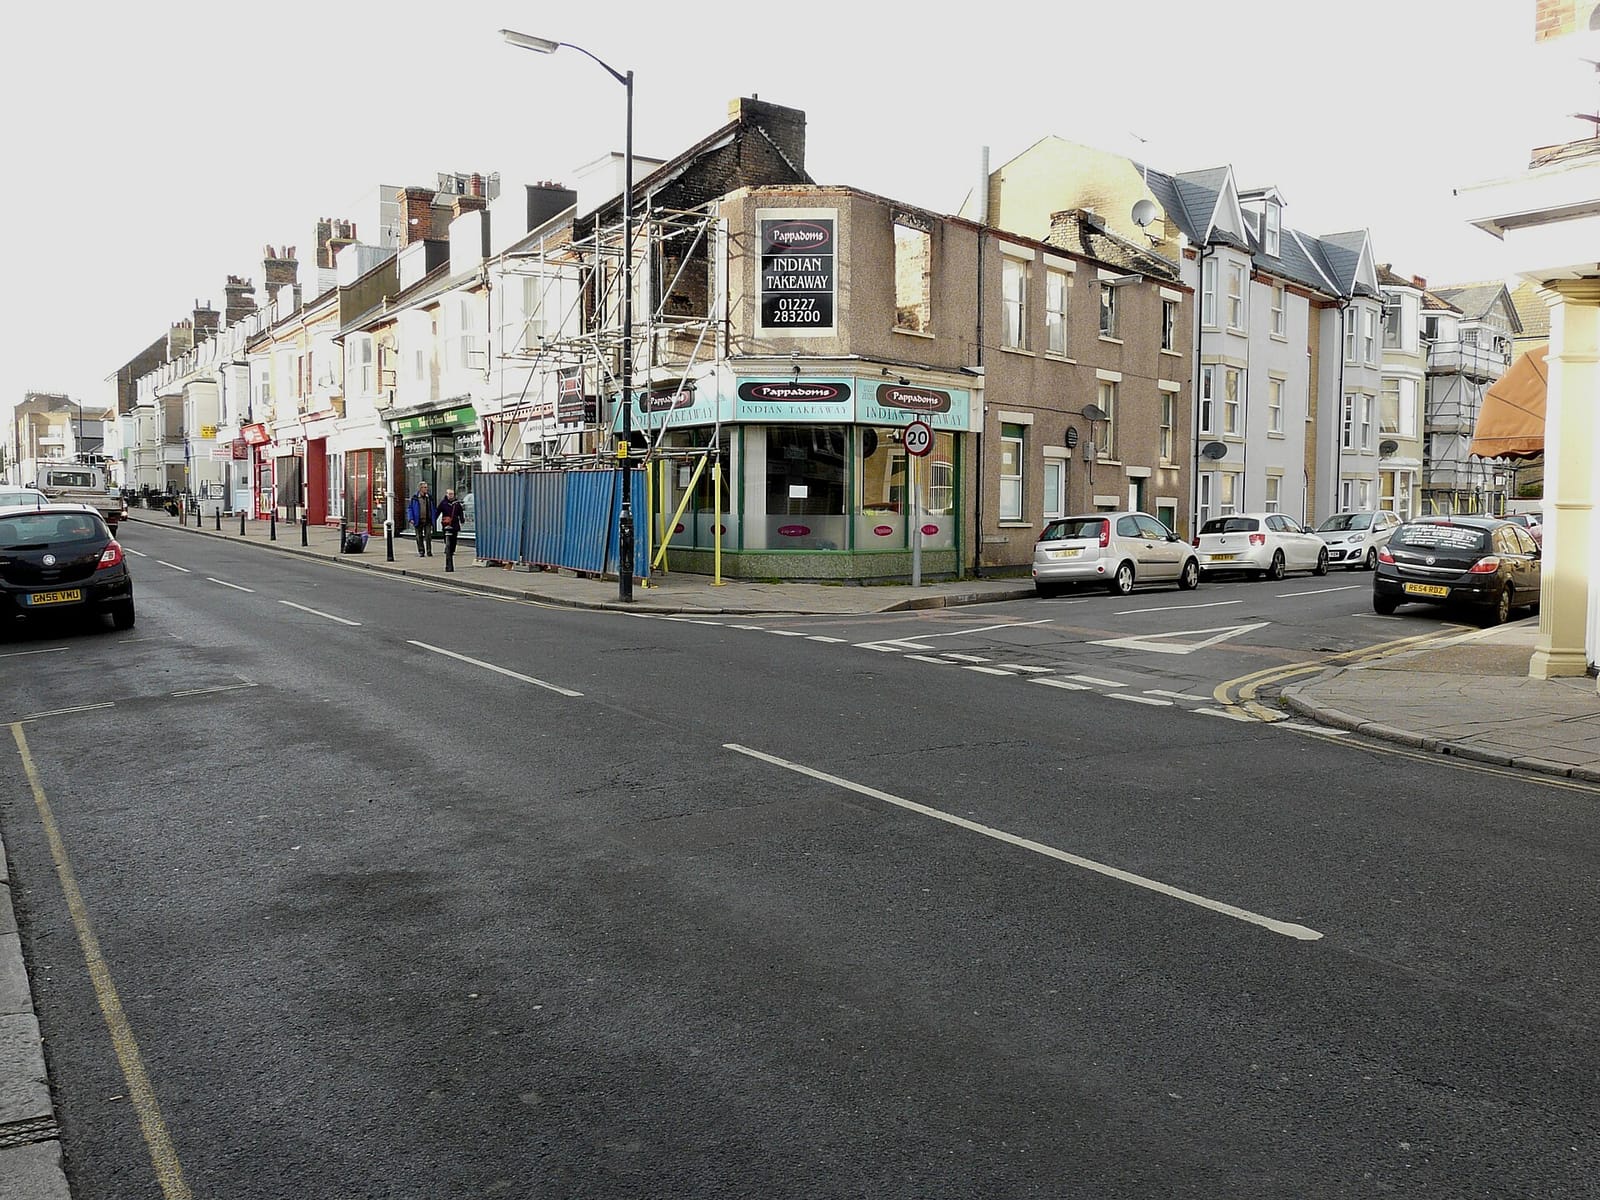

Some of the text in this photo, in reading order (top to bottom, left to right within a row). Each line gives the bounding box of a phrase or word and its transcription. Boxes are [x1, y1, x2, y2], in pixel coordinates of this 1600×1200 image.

[773, 230, 823, 243] Pappadoms
[773, 258, 822, 272] INDIAN
[766, 275, 828, 289] TAKEAWAY
[779, 299, 815, 310] 01227
[773, 310, 820, 322] 283200
[762, 387, 830, 397] Pappadoms
[893, 391, 939, 405] Pappadoms
[742, 405, 847, 414] INDIAN TAKEAWAY
[907, 431, 928, 446] 20
[32, 590, 79, 603] GN56 VMU
